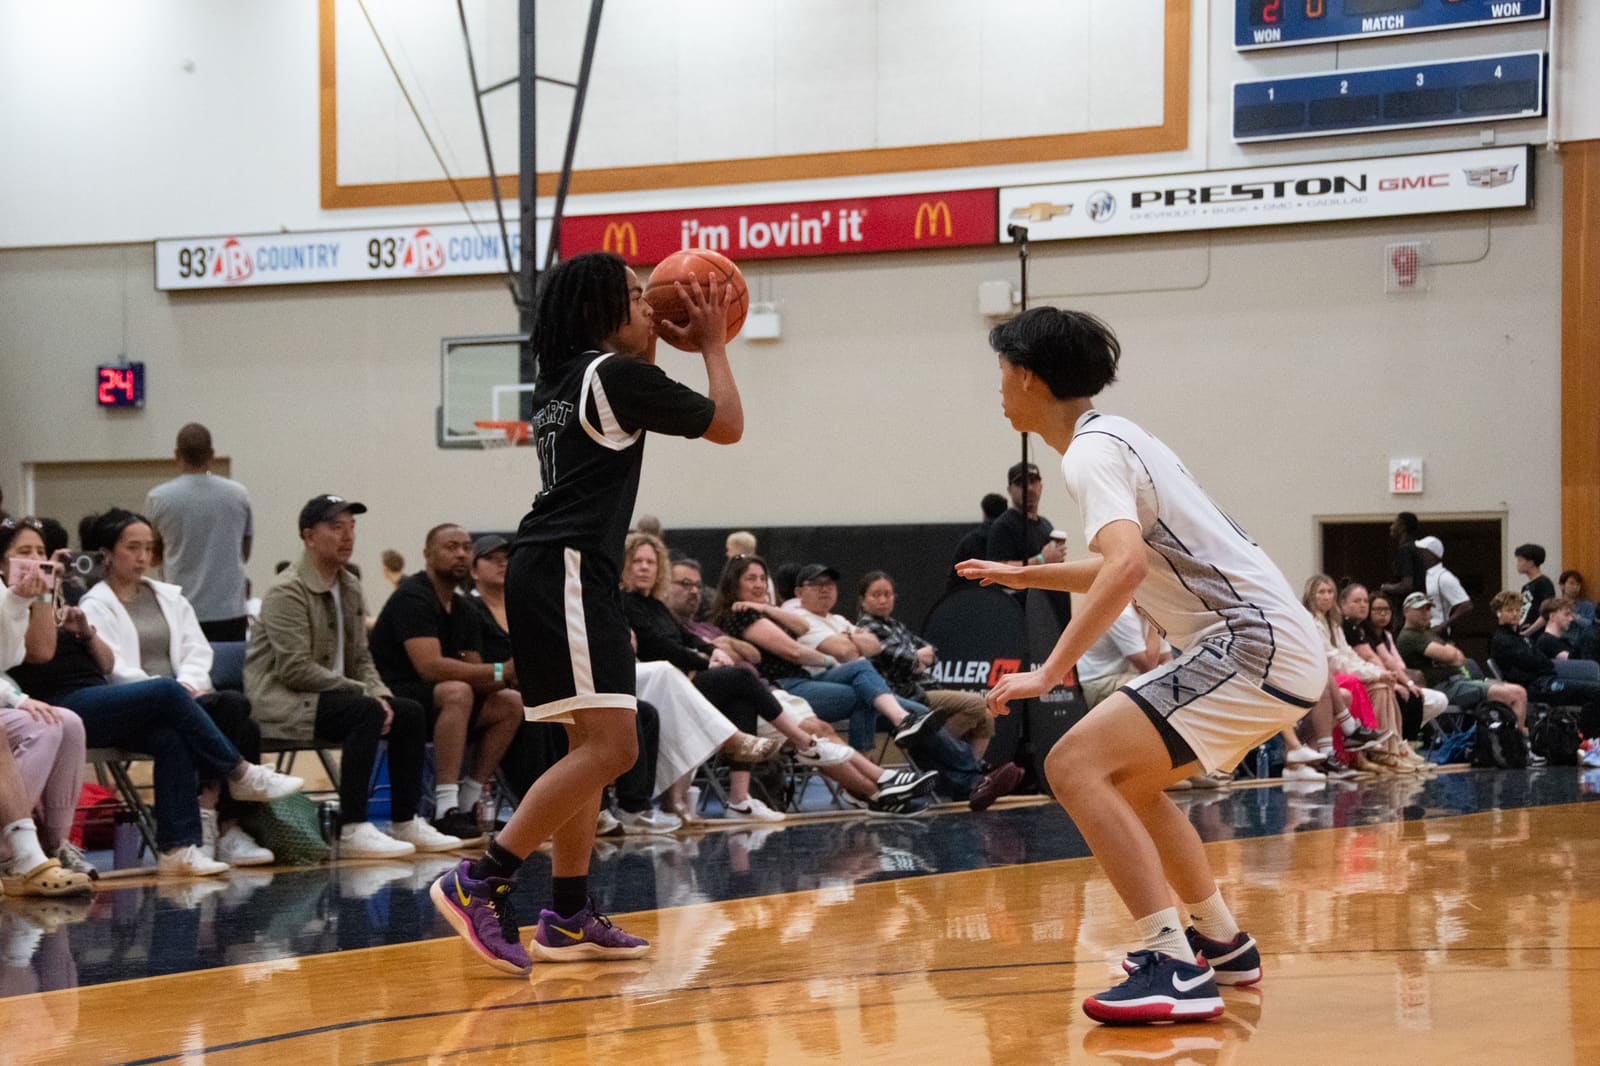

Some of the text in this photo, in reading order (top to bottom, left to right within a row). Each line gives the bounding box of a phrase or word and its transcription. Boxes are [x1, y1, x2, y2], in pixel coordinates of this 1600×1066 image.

[1362, 14, 1404, 32] MATCH
[1491, 3, 1521, 17] WON
[1253, 28, 1280, 43] WON
[1268, 64, 1502, 101] 1 2 3 4
[1131, 173, 1449, 208] PRESTON GMC
[838, 208, 863, 242] it
[256, 244, 339, 272] COUNTRY
[98, 368, 134, 404] 24
[924, 660, 992, 683] ALLER
